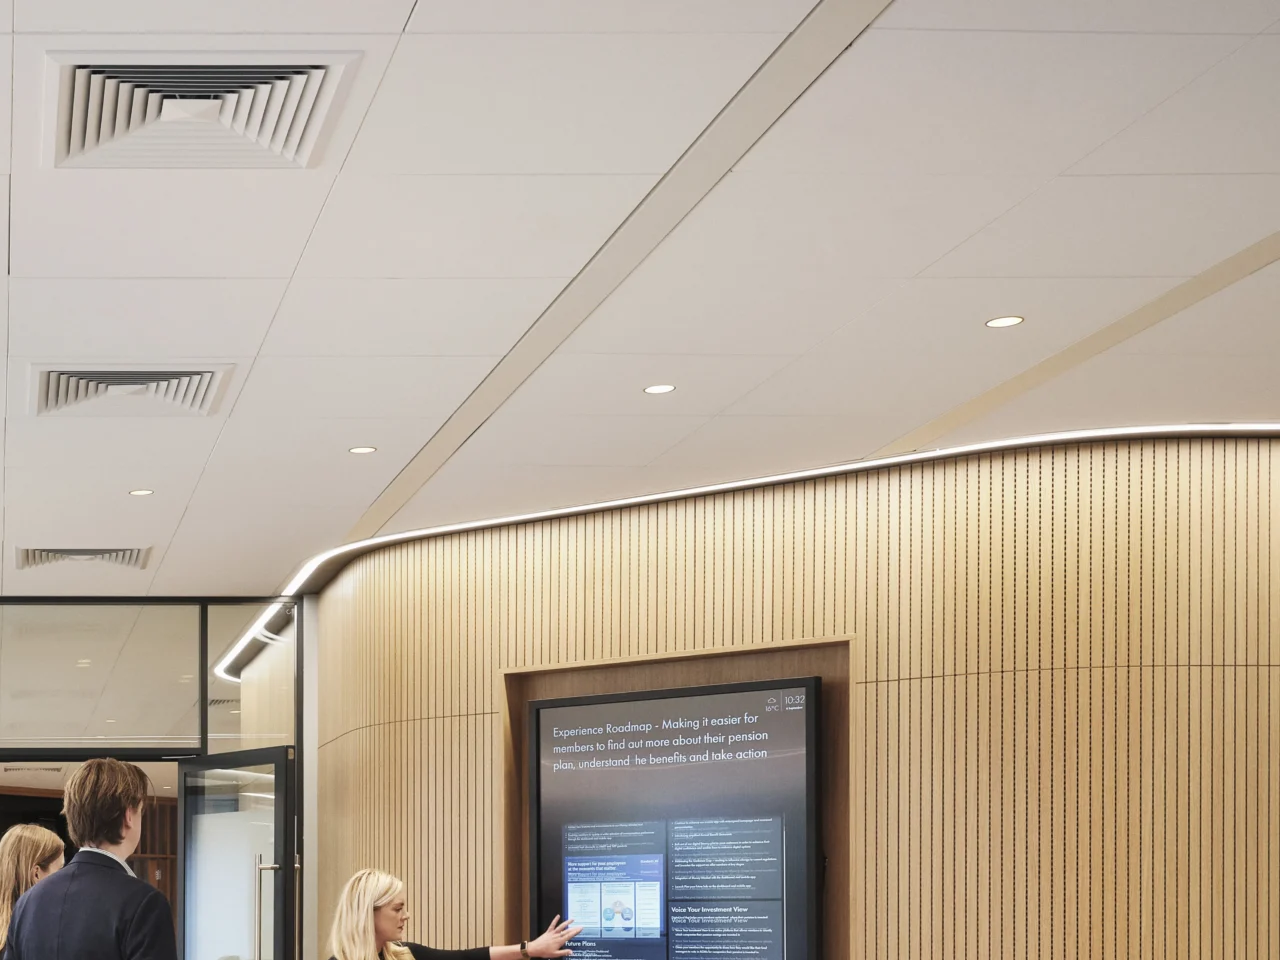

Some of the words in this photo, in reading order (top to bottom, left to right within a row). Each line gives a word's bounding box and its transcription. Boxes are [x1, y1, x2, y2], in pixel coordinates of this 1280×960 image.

[784, 695, 805, 704] 10:32
[553, 726, 603, 739] Experience
[606, 721, 652, 733] Roadmap
[662, 717, 699, 730] Making
[702, 717, 708, 727] it
[711, 715, 741, 726] easier
[744, 712, 759, 724] for
[553, 742, 594, 754] members
[596, 742, 605, 751] to
[607, 738, 625, 750] find
[645, 739, 669, 748] more
[672, 734, 701, 746] about
[703, 732, 725, 744] their
[728, 731, 768, 745] pension
[553, 759, 576, 772] plan,
[578, 755, 630, 769] understand
[649, 751, 687, 764] benefits
[689, 750, 709, 762] and
[711, 749, 733, 761] take
[735, 748, 767, 760] action
